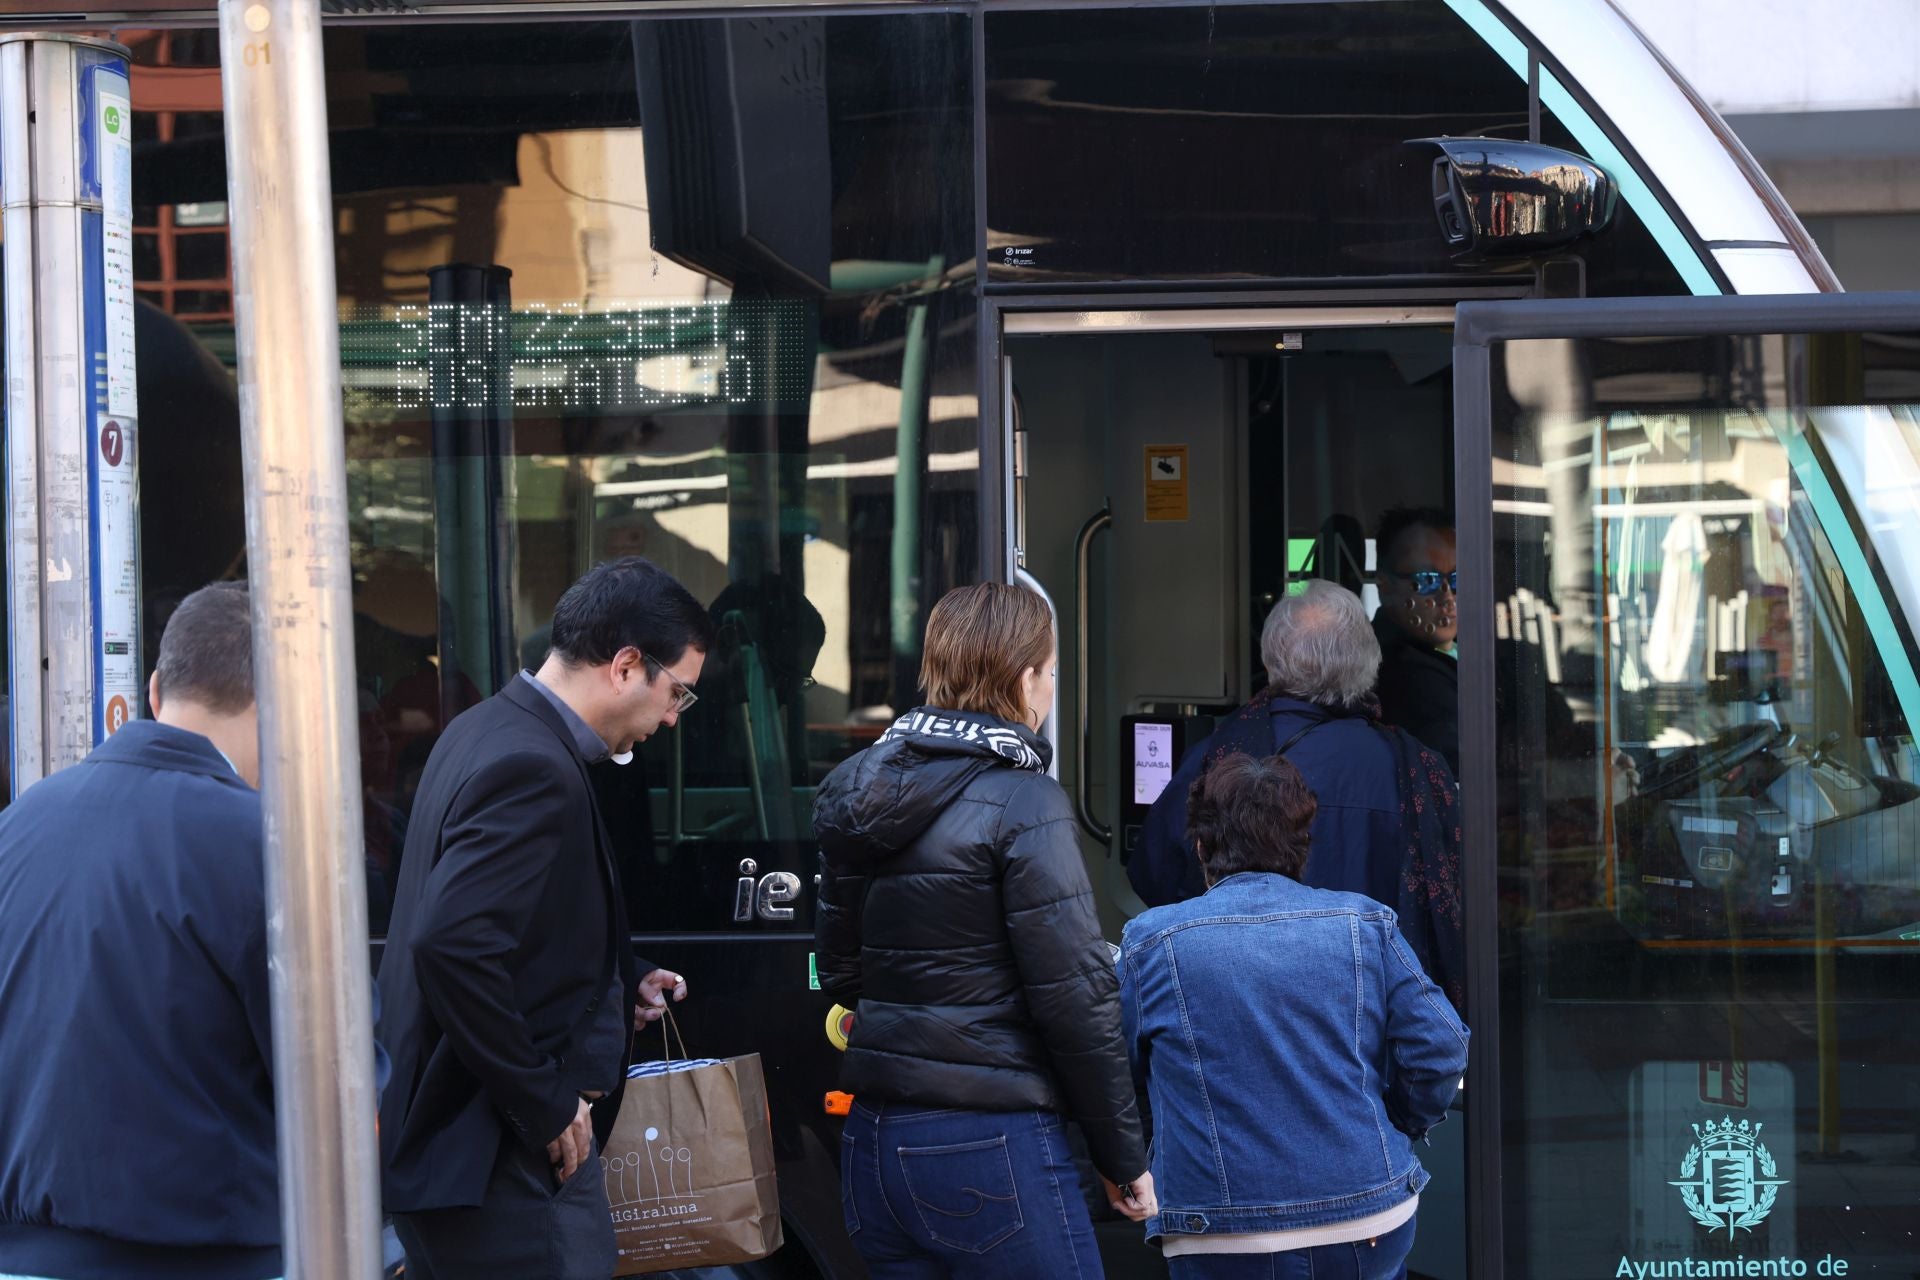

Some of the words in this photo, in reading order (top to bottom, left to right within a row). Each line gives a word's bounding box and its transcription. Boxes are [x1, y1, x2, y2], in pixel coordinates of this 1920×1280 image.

[242, 42, 271, 67] 01
[525, 302, 584, 351] 22
[606, 300, 746, 350] SEPT.
[397, 360, 488, 408] BUS
[510, 355, 751, 406] GRATUITO
[108, 430, 118, 457] 7
[1136, 760, 1171, 769] AUVASA
[735, 858, 801, 921] ie
[1615, 1255, 1808, 1280] Ayuntamiento
[1816, 1254, 1849, 1277] de
